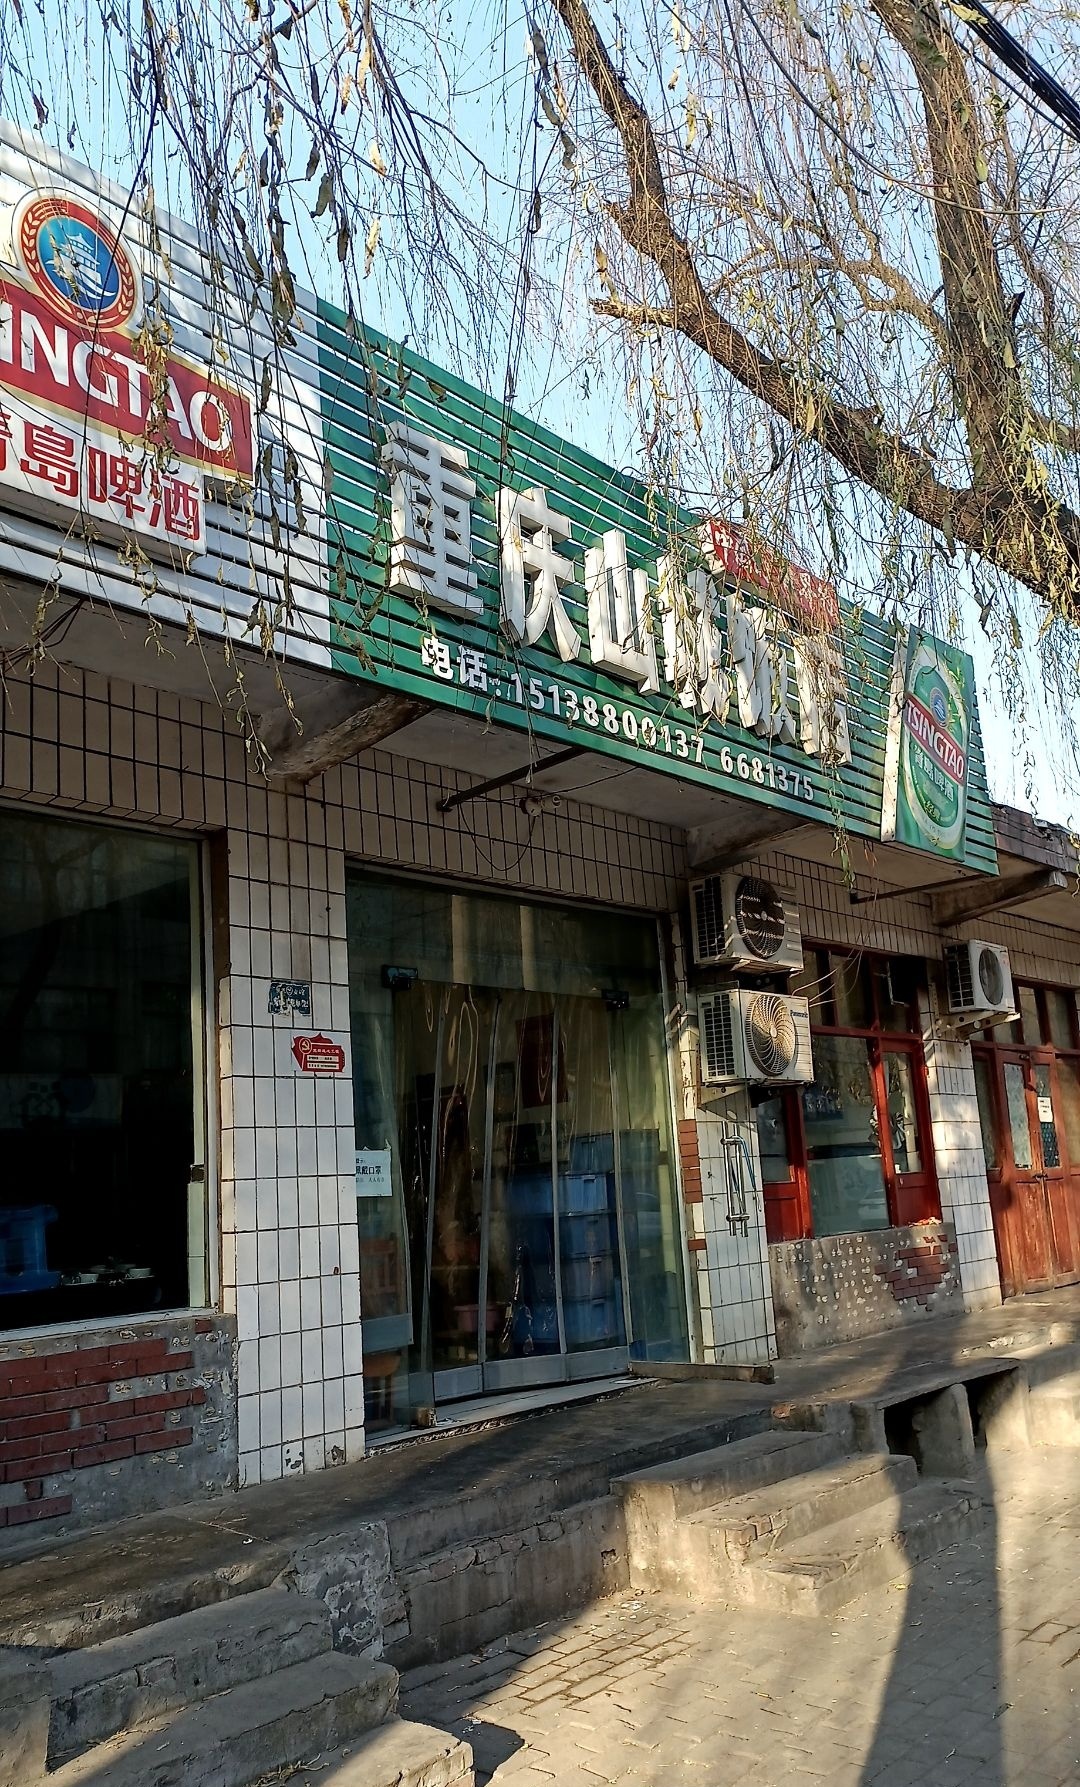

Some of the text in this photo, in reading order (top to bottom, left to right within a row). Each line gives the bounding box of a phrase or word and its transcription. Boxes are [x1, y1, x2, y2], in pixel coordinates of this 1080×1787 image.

[0, 411, 200, 541] 島啤酒
[720, 746, 814, 801] 6681375
[906, 699, 964, 779] TSINGTAO
